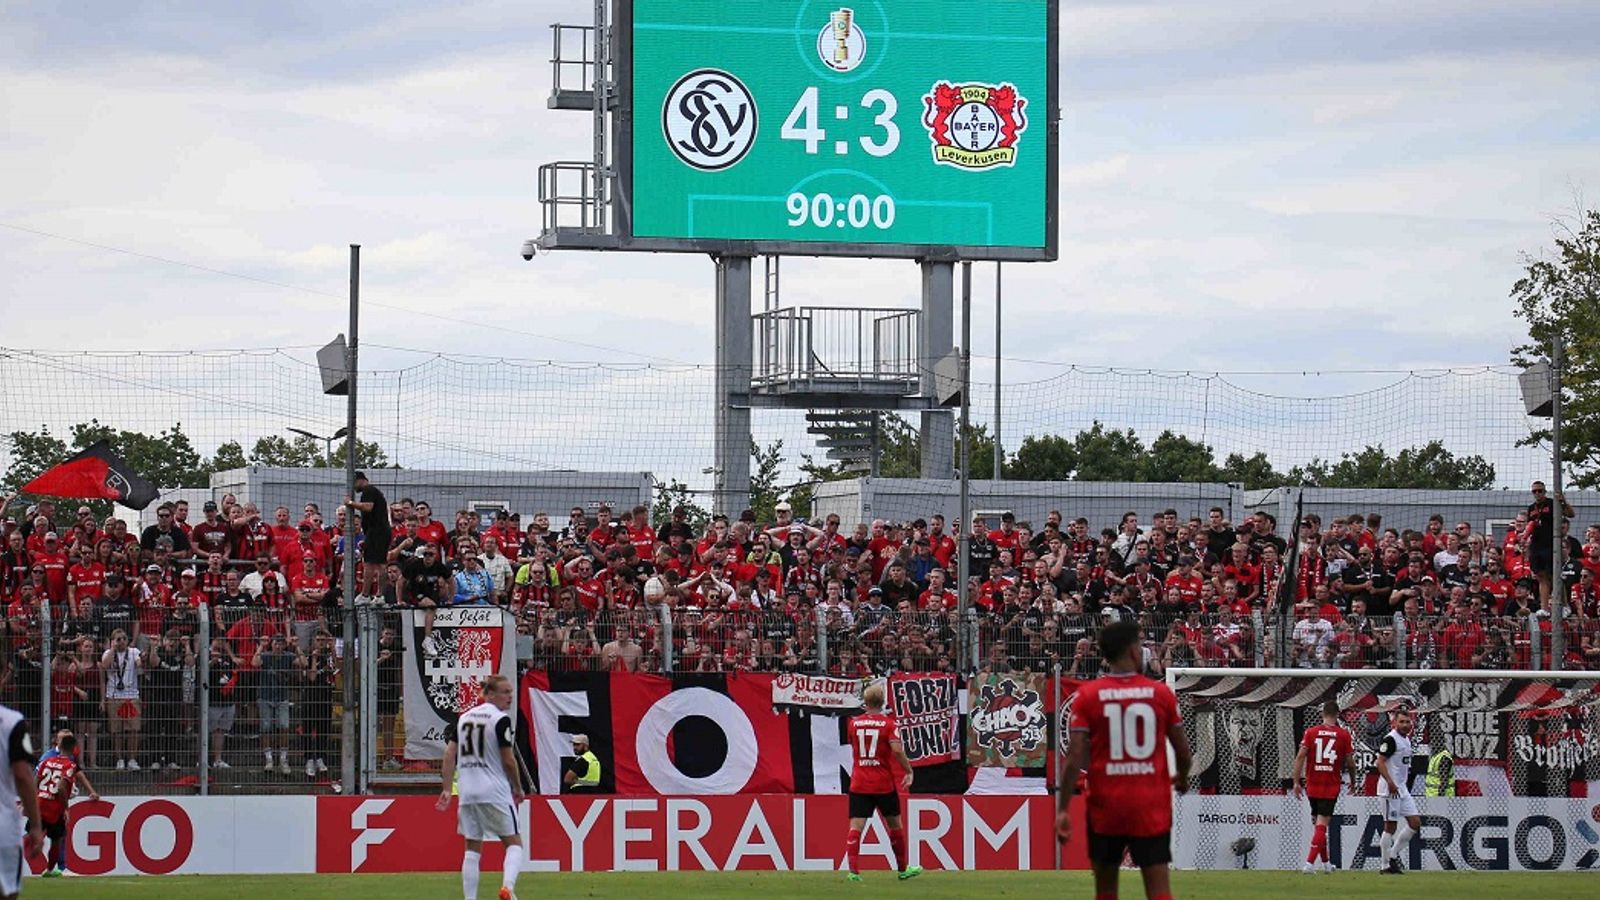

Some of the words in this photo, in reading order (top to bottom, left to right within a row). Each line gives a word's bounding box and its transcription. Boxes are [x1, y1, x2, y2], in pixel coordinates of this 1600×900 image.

[963, 88, 987, 100] 1904
[954, 121, 996, 132] BAYER
[940, 149, 1008, 166] Leverkusen
[787, 192, 896, 230] 90:00
[892, 677, 958, 717] FORZ
[1439, 681, 1500, 707] WEST
[973, 702, 1044, 732] CHAOS
[1103, 702, 1157, 761] 10
[1439, 710, 1500, 735] SIDE
[460, 721, 487, 758] 31
[856, 728, 880, 758] 17
[1314, 737, 1338, 764] 14
[39, 767, 63, 794] 25
[24, 798, 193, 876] GO
[500, 798, 1031, 872] LYERALARM
